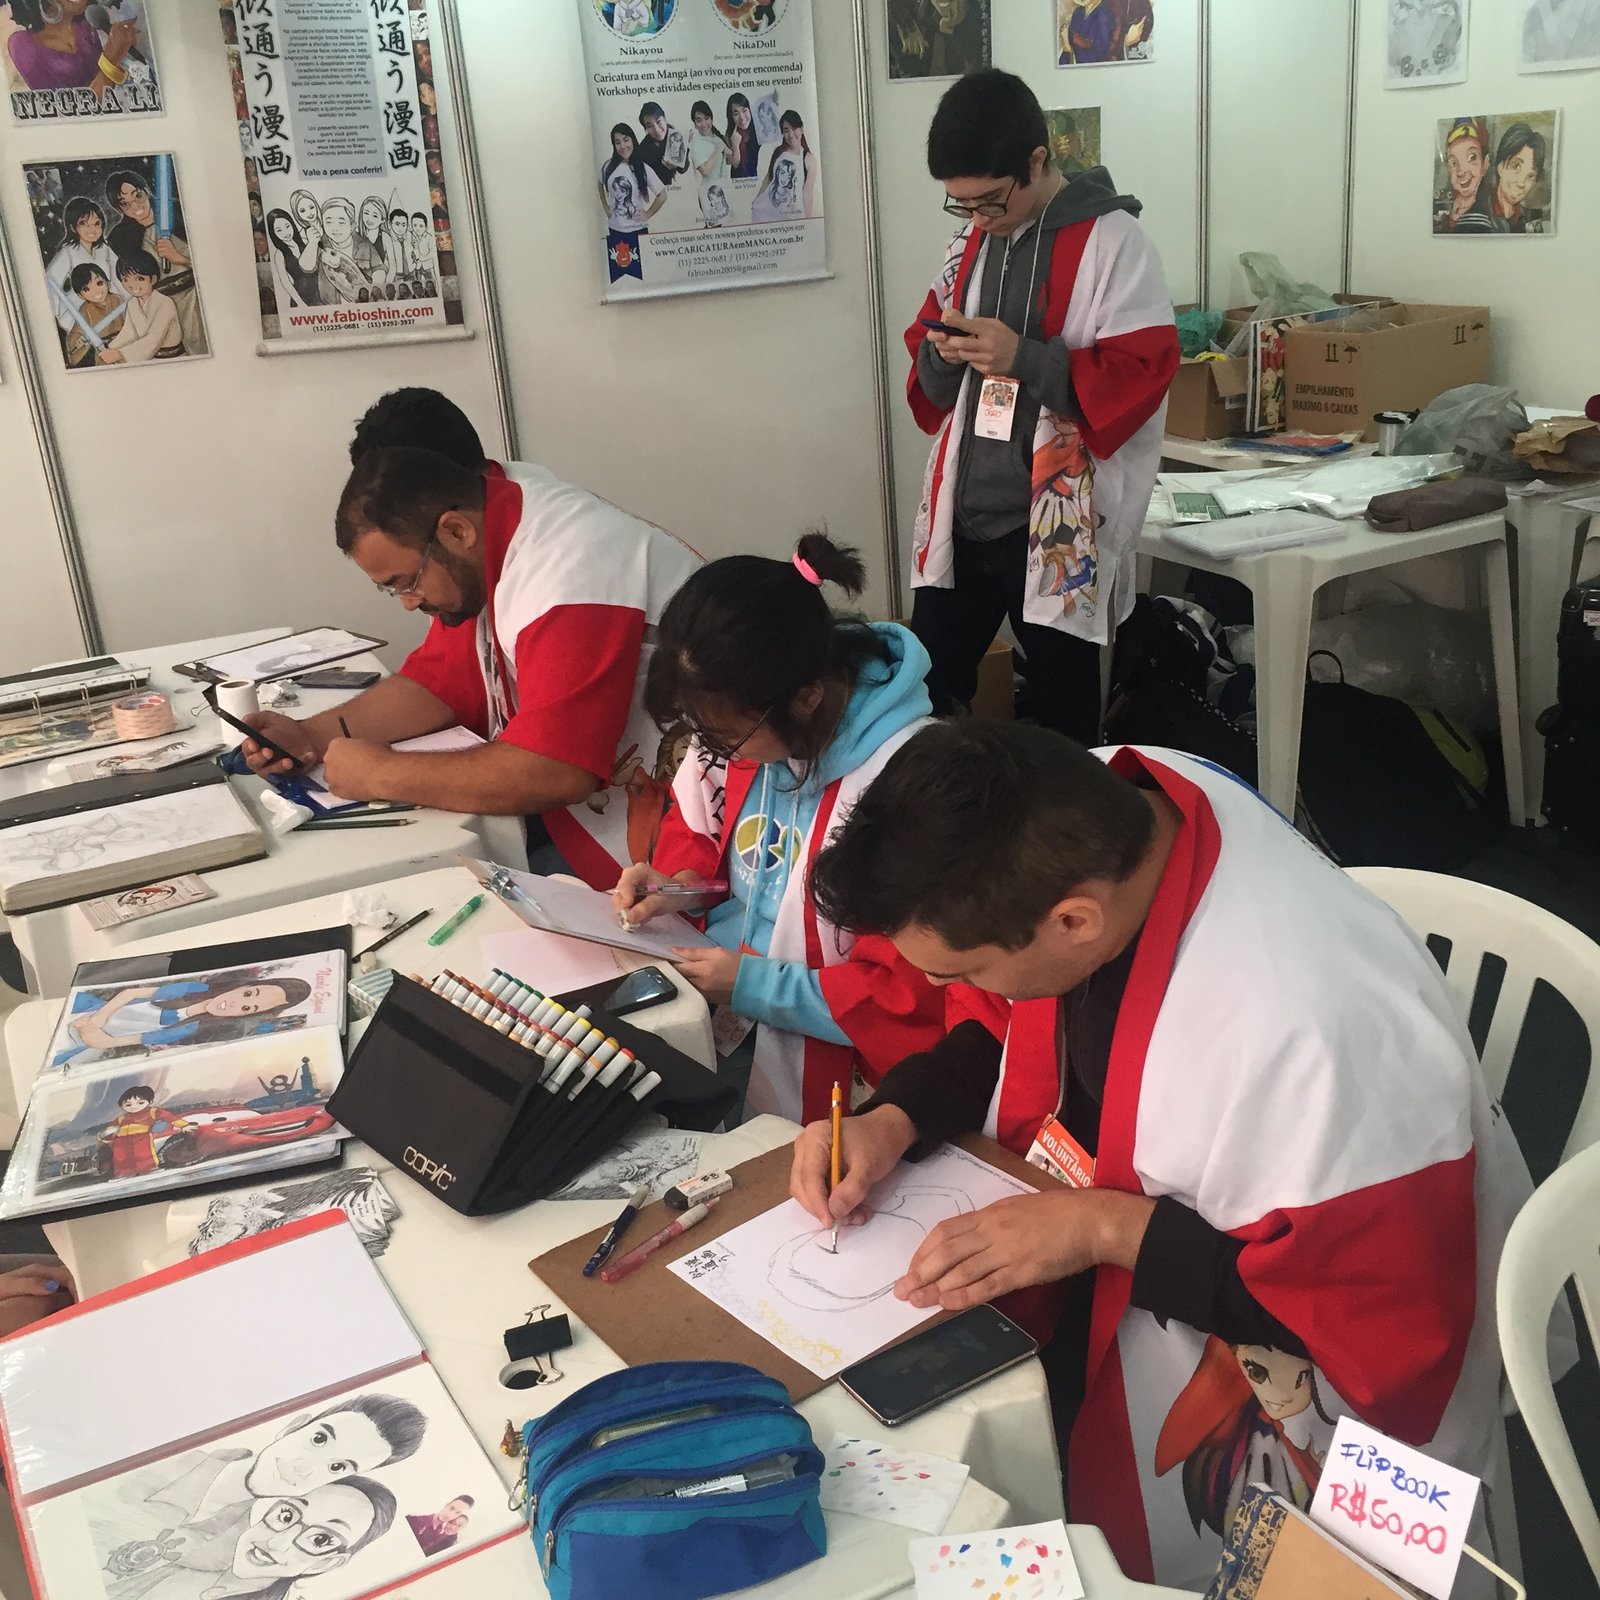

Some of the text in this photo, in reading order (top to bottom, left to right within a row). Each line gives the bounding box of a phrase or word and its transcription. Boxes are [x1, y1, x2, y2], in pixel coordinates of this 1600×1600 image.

[619, 46, 664, 57] Nikayou
[733, 39, 776, 50] NikaDoll
[593, 62, 803, 83] Caricatura em Mangá (ao vivo ou por encomenda)
[596, 75, 802, 97] Workshops e atividades especiais em seu evento!
[10, 83, 162, 120] NEGRA LI
[302, 168, 321, 176] Vale
[329, 168, 349, 177] pena
[350, 166, 383, 175] conferir!
[649, 235, 679, 246] Conheça
[696, 233, 714, 242] sobre
[736, 228, 764, 239] produtos
[654, 235, 804, 257] www.CARICATURAemMANGA.com.br
[677, 258, 692, 268] (11)
[289, 306, 434, 326] www.fabioshin.com
[1295, 383, 1354, 398] EMPILHAMENTO
[1331, 403, 1359, 415] CAIXAS
[1042, 1129, 1091, 1188] VOLUNTÁRIO
